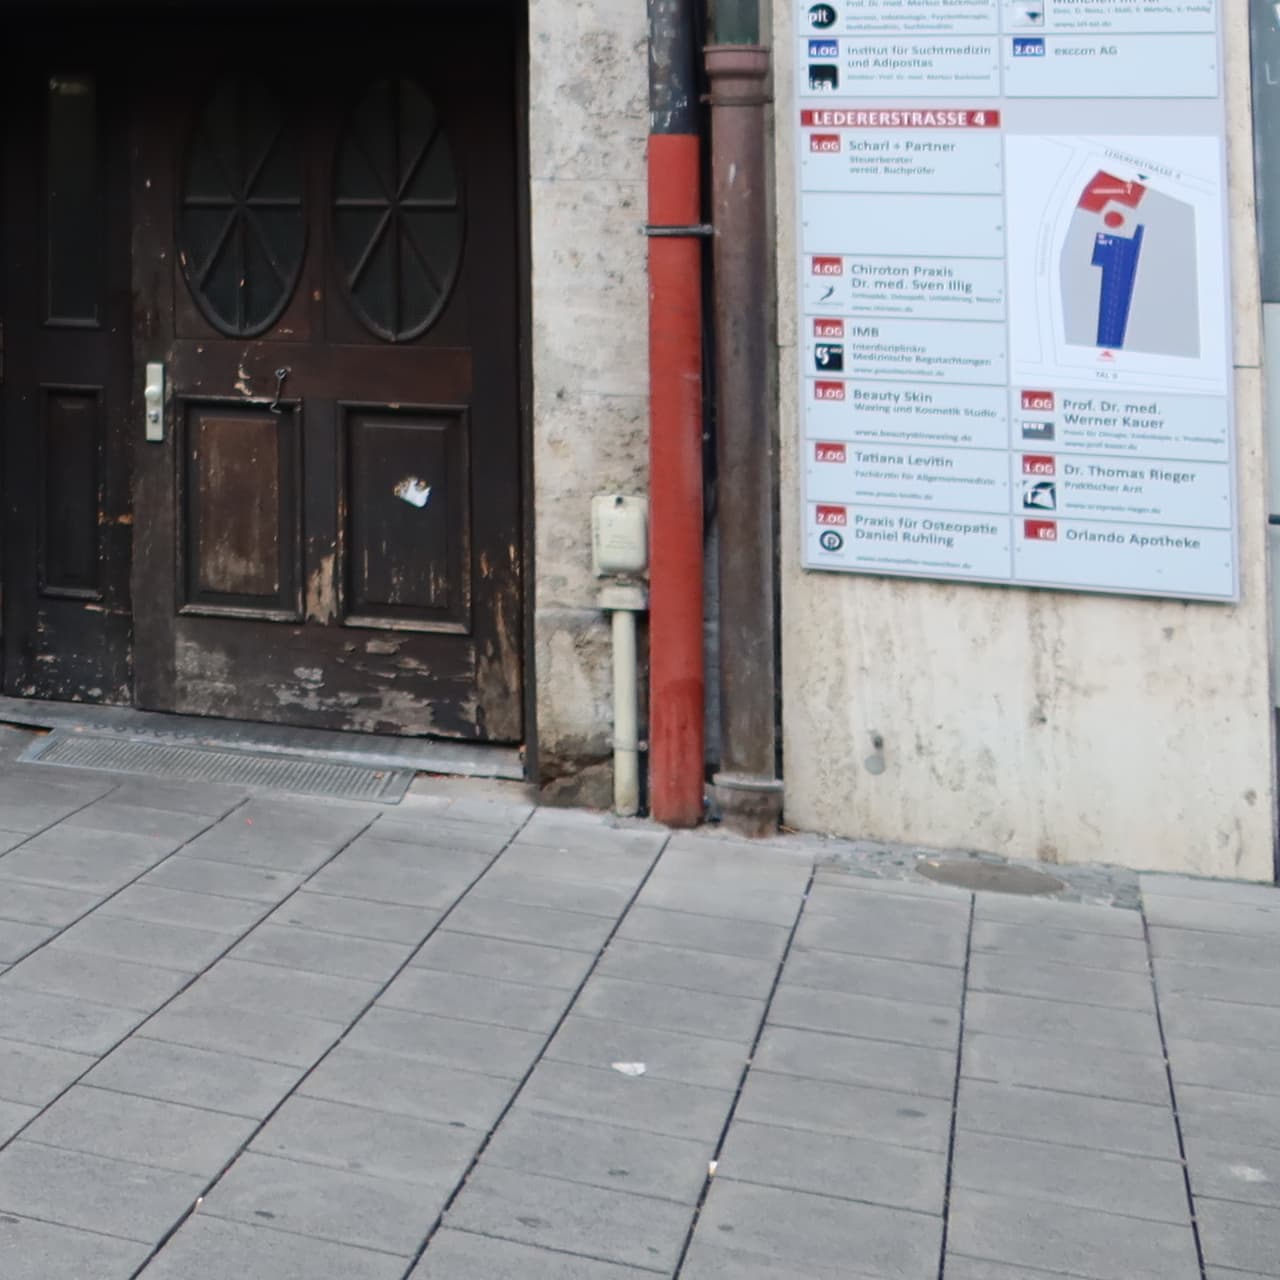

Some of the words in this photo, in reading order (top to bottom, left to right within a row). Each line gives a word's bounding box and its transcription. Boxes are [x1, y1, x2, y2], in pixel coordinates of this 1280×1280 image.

[847, 46, 888, 55] Institut
[892, 45, 908, 55] für
[911, 45, 991, 55] Suchtmedizin
[848, 58, 869, 67] und
[873, 58, 933, 69] Adipositas
[814, 111, 967, 126] LEDERERSTRASSE
[974, 112, 986, 126] 4
[905, 141, 956, 152] Partner
[914, 266, 953, 277] Praxis
[851, 278, 868, 289] Dr.
[874, 279, 908, 290] med.
[912, 280, 947, 290] Sven
[852, 326, 879, 337] IMB
[853, 389, 900, 403] Beauty
[904, 391, 933, 403] Skin
[1063, 399, 1096, 411] Prof.
[1100, 401, 1120, 413] Dr.
[1125, 403, 1161, 415] med.
[1064, 413, 1117, 426] Werner
[1122, 416, 1165, 429] Kauer
[855, 452, 904, 465] Tatiana
[908, 454, 953, 468] Levitin
[1064, 464, 1083, 476] Dr.
[1088, 465, 1145, 479] Thomas
[1150, 469, 1196, 483] Rieger
[855, 514, 895, 528] Praxis
[898, 516, 918, 529] für
[855, 529, 898, 542] Daniel
[1066, 528, 1125, 544] Orlando
[1129, 532, 1201, 549] Apotheke
